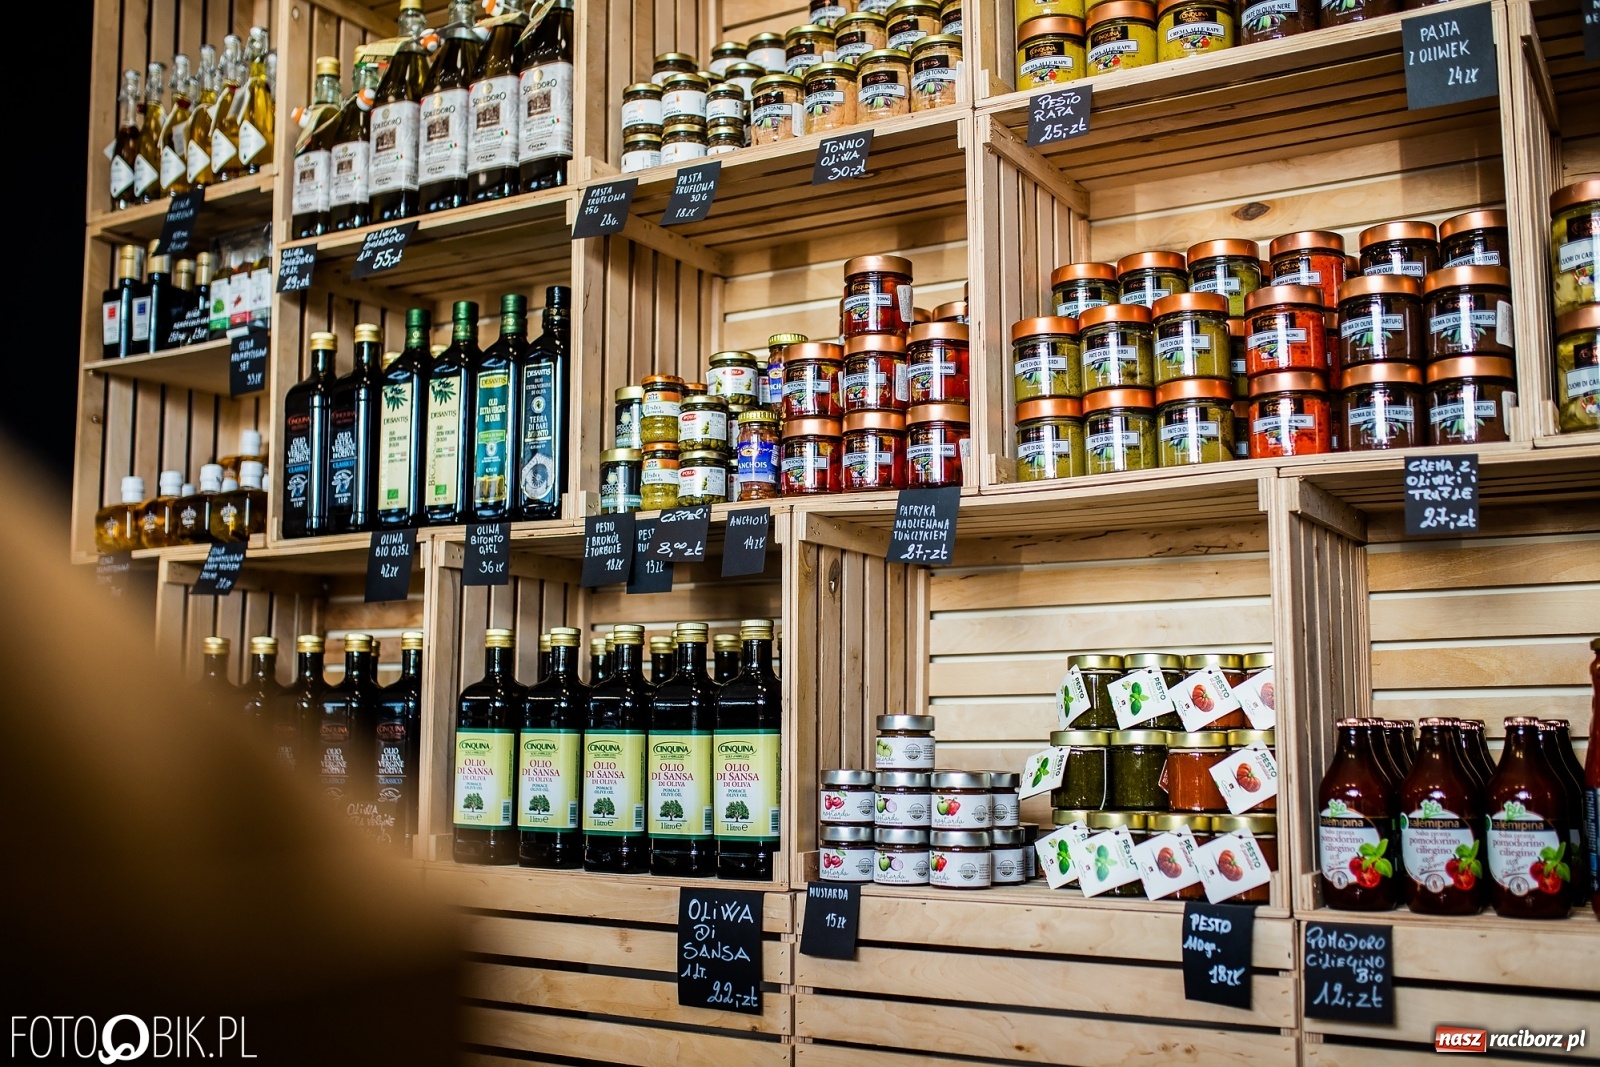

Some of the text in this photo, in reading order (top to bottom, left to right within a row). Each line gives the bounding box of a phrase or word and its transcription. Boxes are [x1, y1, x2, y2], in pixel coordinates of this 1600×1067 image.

[1169, 28, 1188, 38] CREMA
[1420, 21, 1460, 42] PASTA
[1420, 39, 1470, 63] OLIWEK
[1022, 62, 1039, 73] CREMA
[523, 79, 557, 95] SOLEDORO
[473, 92, 506, 107] SOLEDORO
[1038, 92, 1081, 109] PESTO
[1034, 105, 1074, 122] RAPA
[822, 138, 865, 154] TONNO
[678, 172, 702, 185] PASTA
[591, 186, 612, 197] PASTA
[1472, 314, 1495, 322] TARTUFO
[527, 368, 551, 377] DESANTIS
[482, 376, 506, 387] DESANTIS
[431, 410, 457, 419] DESANTIS
[1350, 411, 1365, 420] CREMA
[384, 416, 409, 425] DESANTIS
[536, 422, 547, 430] BARI
[1408, 459, 1453, 473] CREMA
[900, 505, 935, 517] PAPRYKA
[596, 521, 615, 533] PESTO
[896, 519, 949, 529] NADZIEWANA
[375, 545, 389, 557] BIO
[1074, 677, 1085, 699] PESTO
[1154, 677, 1167, 701] PESTO
[1213, 675, 1230, 699] PESTO
[384, 747, 399, 755] OLIO
[461, 742, 490, 750] CINQUINA
[589, 744, 620, 752] CINQUINA
[656, 745, 688, 754] CINQUINA
[720, 745, 754, 753] CINQUINA
[378, 760, 404, 768] VERGINE
[530, 760, 552, 768] OLIO
[594, 761, 616, 770] OLIO
[660, 763, 684, 771] OLIO
[725, 763, 750, 771] OLIO
[1259, 752, 1277, 778] PESTO
[467, 767, 494, 775] SANSA
[533, 768, 560, 777] SANSA
[597, 770, 624, 779] SANSA
[651, 772, 694, 781] DI SANSA
[729, 772, 759, 781] SANSA
[1409, 819, 1459, 830] salemipina
[1492, 821, 1544, 831] salemipina
[1409, 837, 1460, 845] pomodorino
[1493, 839, 1545, 848] pomodorino
[1245, 842, 1261, 868] PESTO
[1416, 846, 1452, 855] ciliegino
[1499, 848, 1536, 858] ciliegino
[809, 887, 848, 900] MUSTARDA
[1189, 912, 1232, 934] PESTO
[1305, 925, 1385, 951] POMODORO
[683, 941, 750, 962] SANSA
